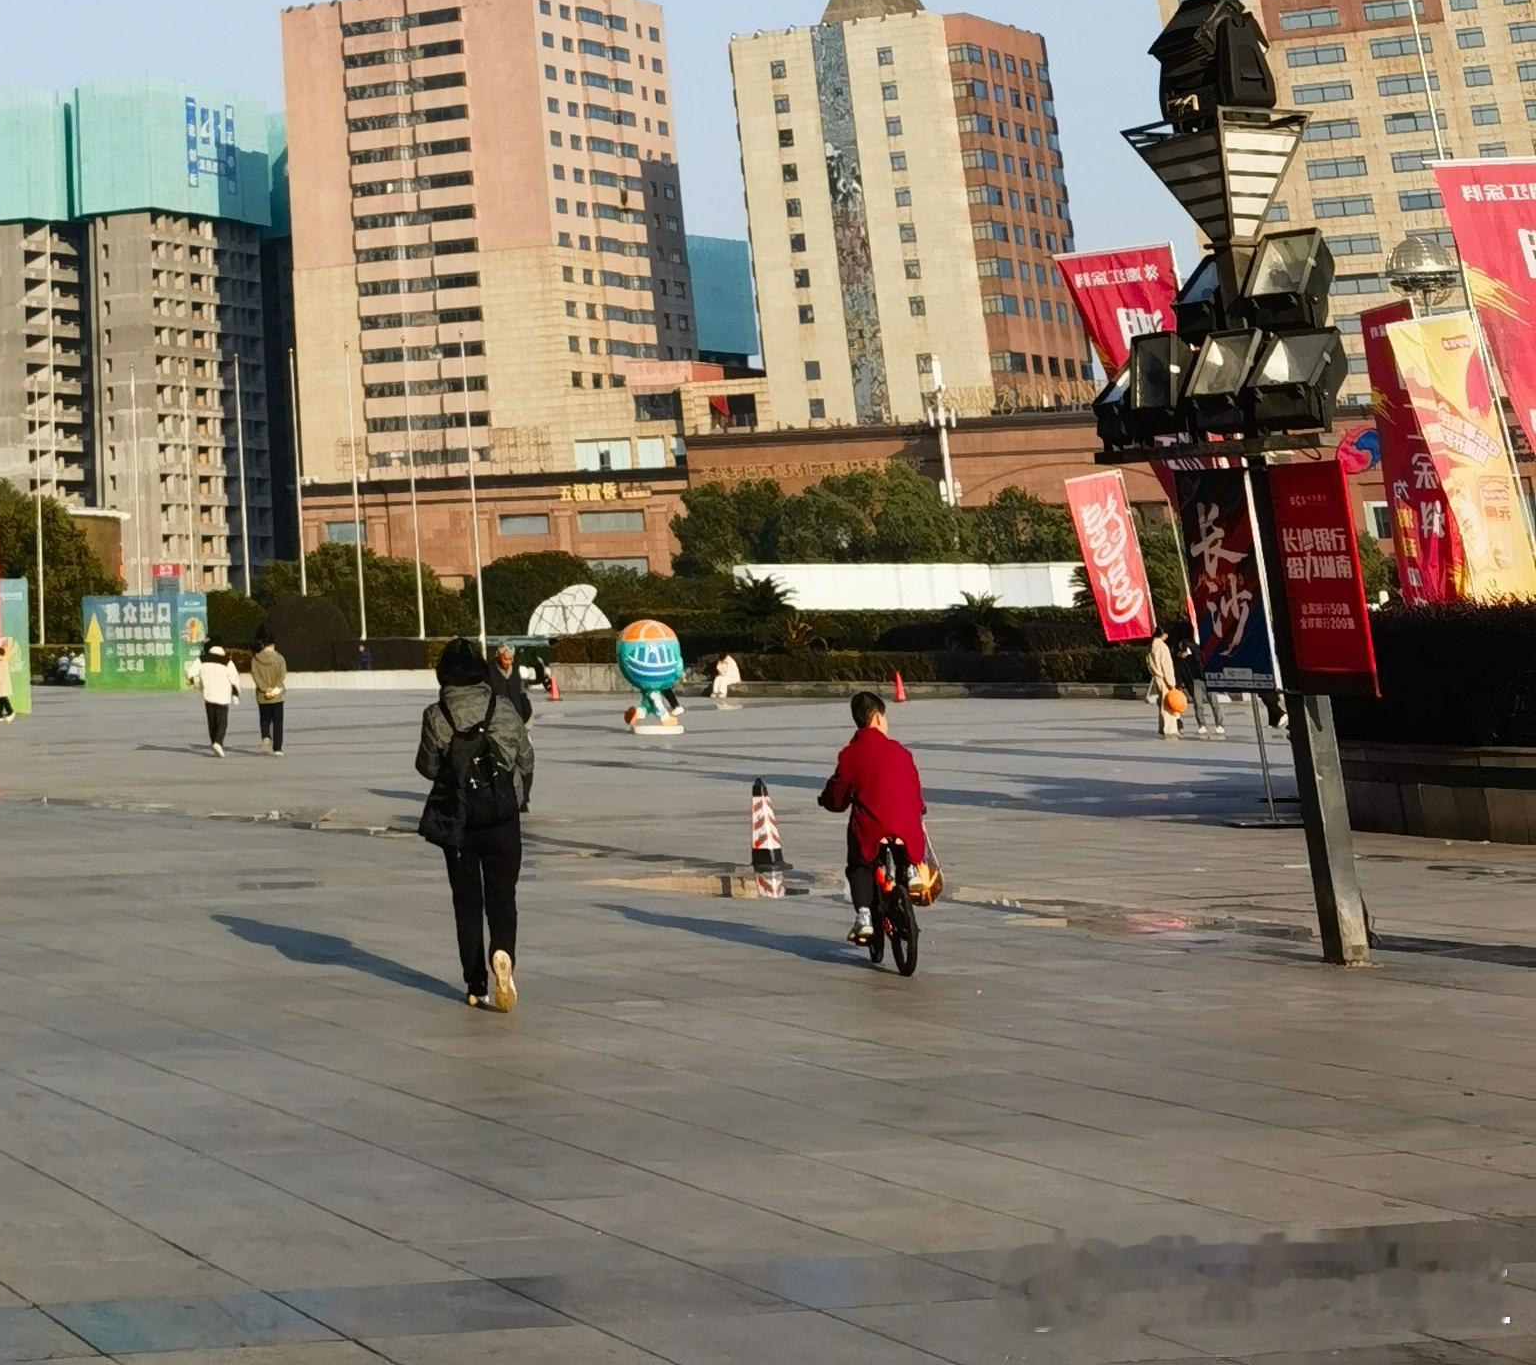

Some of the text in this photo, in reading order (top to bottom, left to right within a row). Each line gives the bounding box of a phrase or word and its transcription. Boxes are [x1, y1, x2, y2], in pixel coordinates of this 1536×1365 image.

[1190, 502, 1252, 657] 长沙
[1282, 527, 1347, 554] 长沙银行
